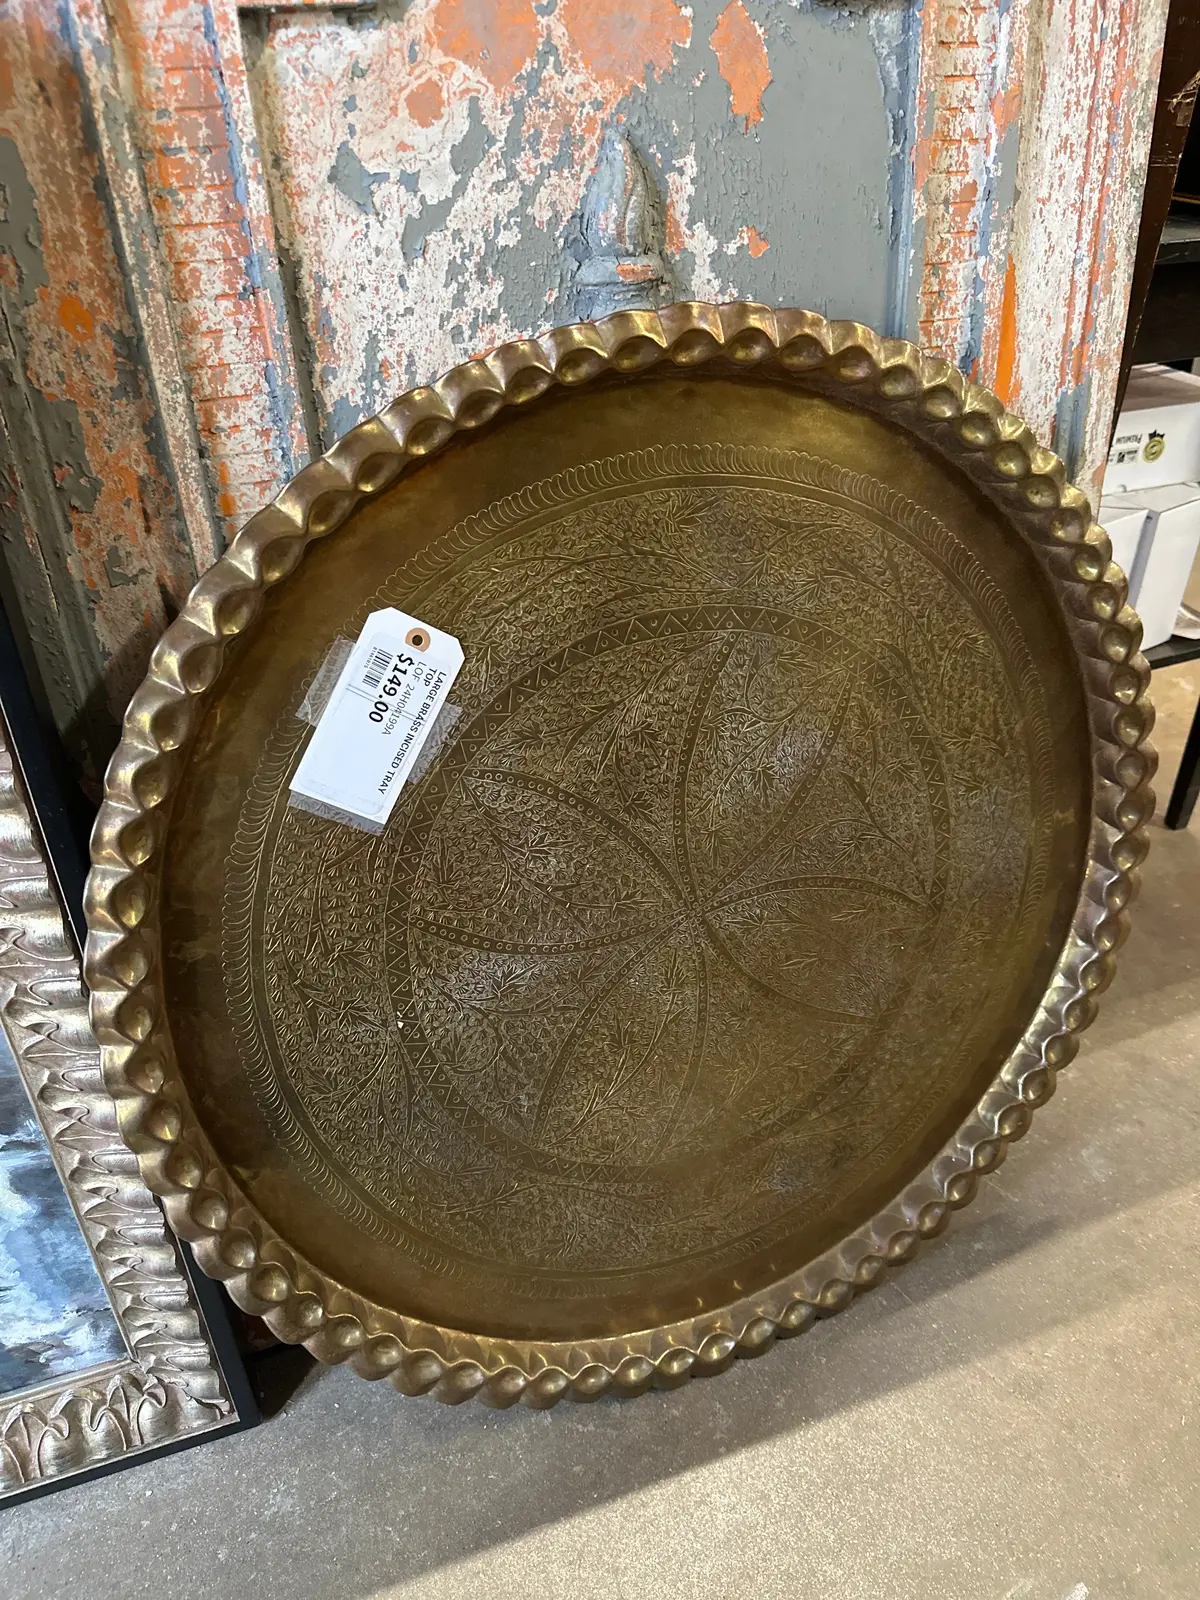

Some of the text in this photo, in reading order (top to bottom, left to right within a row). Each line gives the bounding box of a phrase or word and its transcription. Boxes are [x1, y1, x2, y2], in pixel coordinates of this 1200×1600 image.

[368, 652, 415, 723] $149.00
[381, 661, 427, 736] LOF 24H04199A
[422, 667, 438, 688] TOP
[377, 671, 447, 795] LARGE BRASS INCISED TRAY
